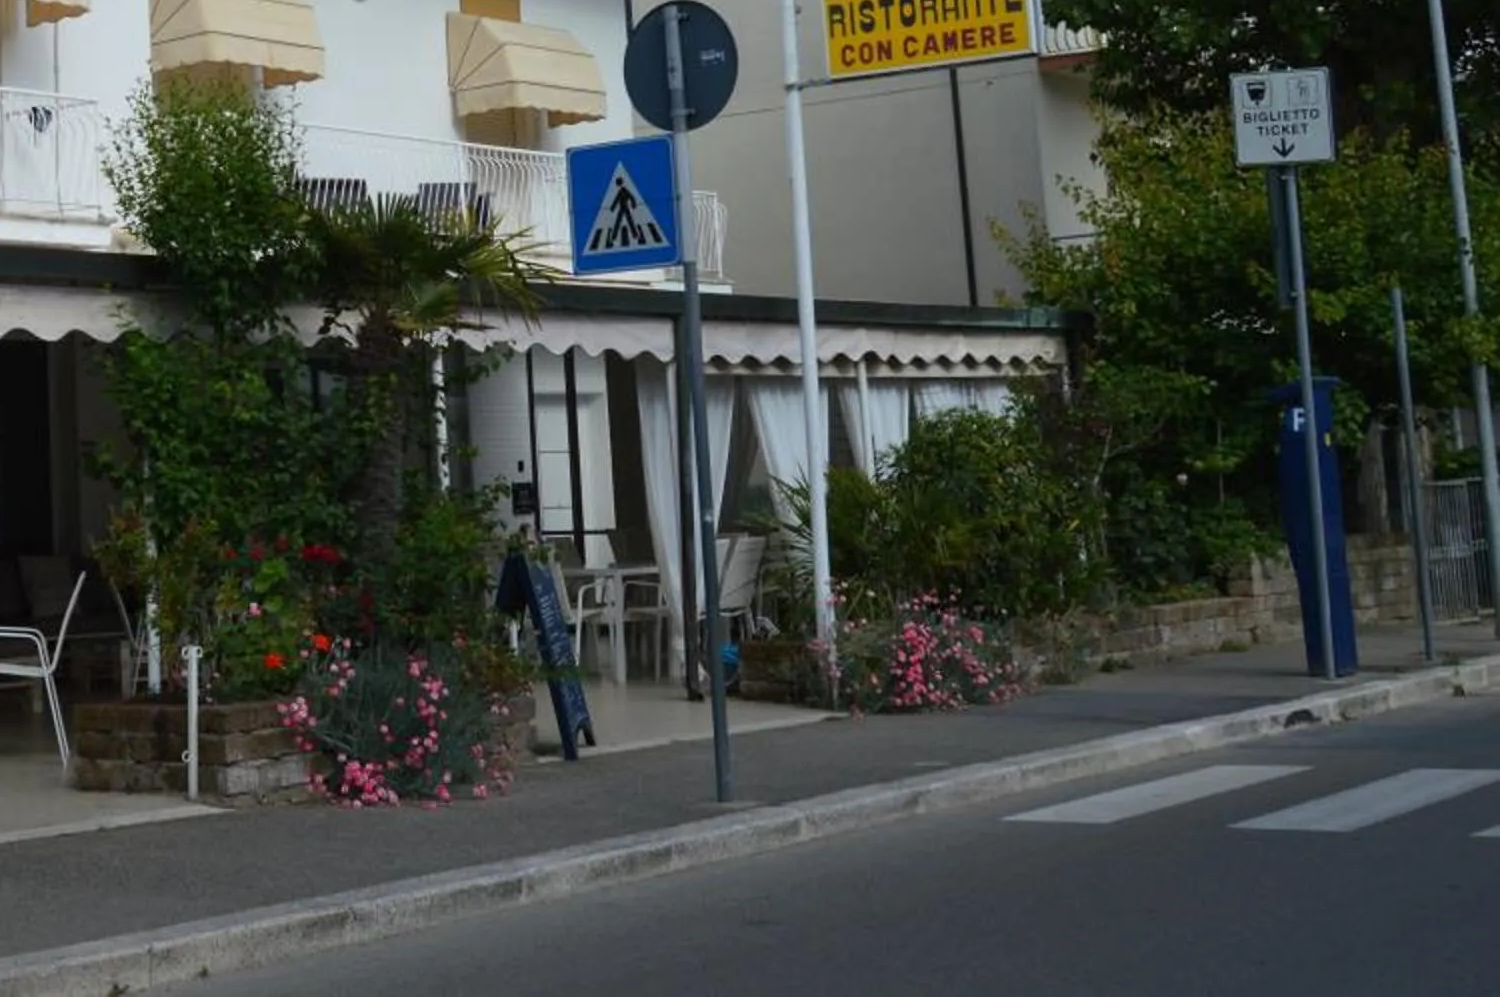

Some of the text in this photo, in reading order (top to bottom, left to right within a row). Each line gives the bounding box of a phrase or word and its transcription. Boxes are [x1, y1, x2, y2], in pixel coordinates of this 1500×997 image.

[841, 23, 1015, 67] CON CAMERE
[1243, 109, 1319, 123] BIGLIETTO
[1256, 123, 1308, 136] TICKET
